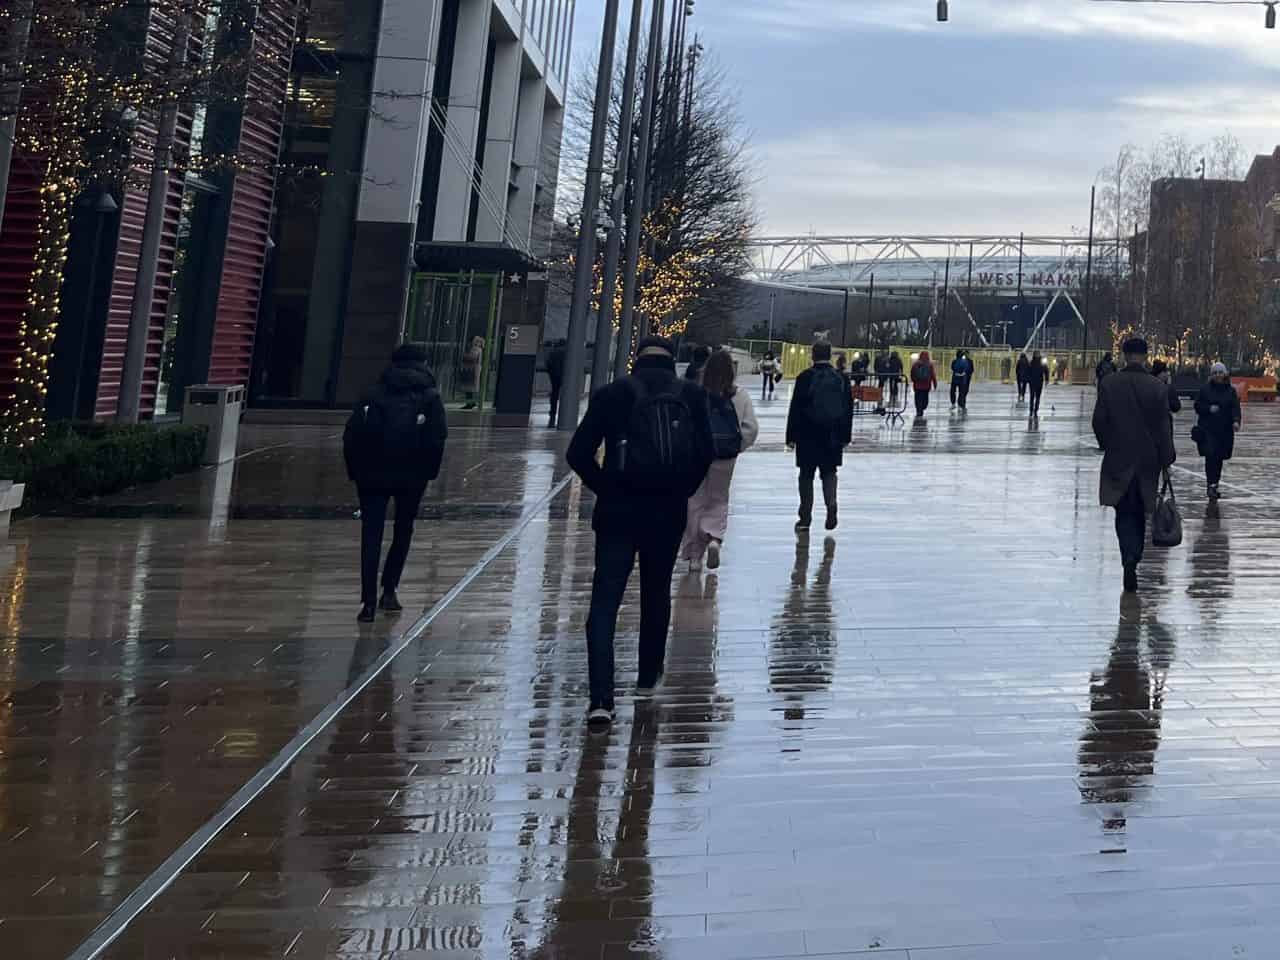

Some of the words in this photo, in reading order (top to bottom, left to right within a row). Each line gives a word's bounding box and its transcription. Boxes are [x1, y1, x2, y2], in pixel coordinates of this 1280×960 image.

[977, 271, 1025, 286] WEST
[1032, 271, 1072, 286] HAM
[510, 326, 520, 340] 5
